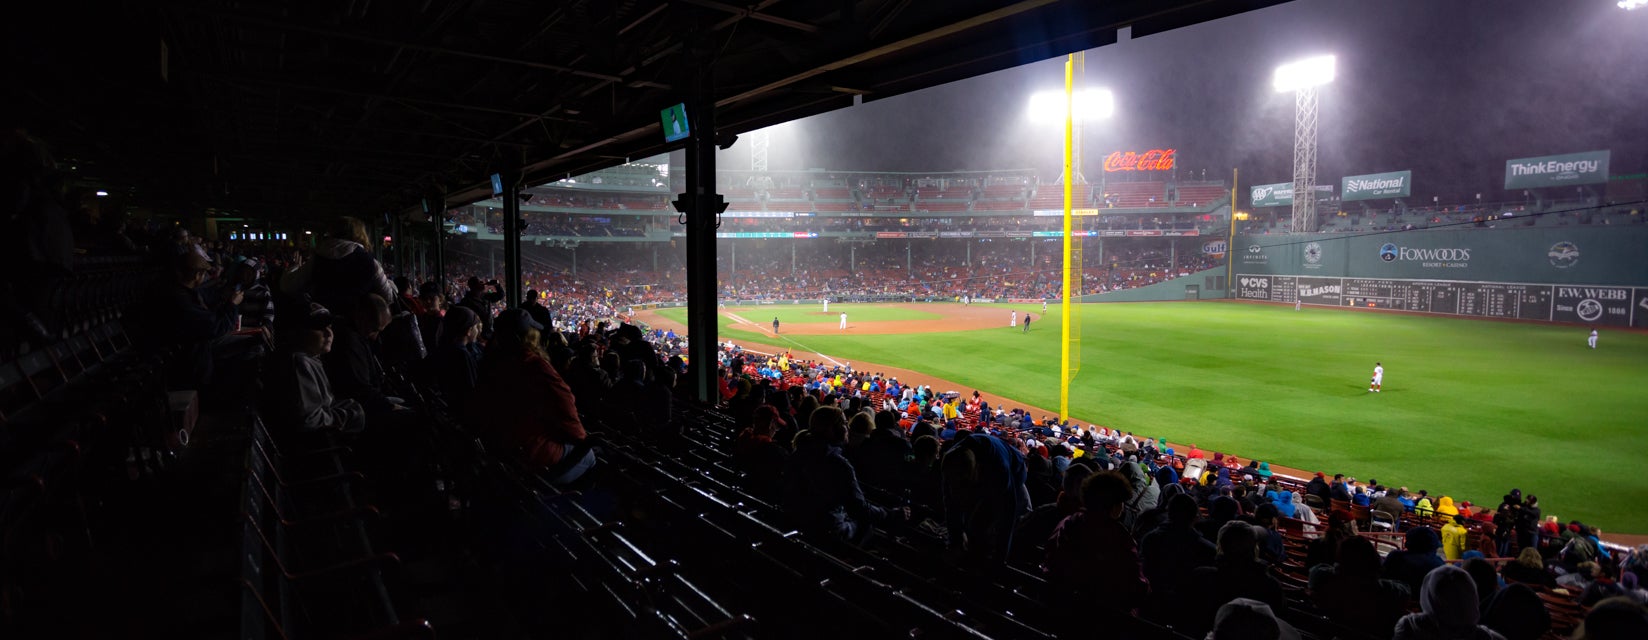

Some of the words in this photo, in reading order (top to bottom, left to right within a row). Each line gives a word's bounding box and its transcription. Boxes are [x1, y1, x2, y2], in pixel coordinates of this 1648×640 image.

[1104, 149, 1176, 172] Coca-Cola
[1359, 176, 1404, 190] National
[1203, 244, 1226, 252] Gulf
[1400, 247, 1471, 260] FOXWOODS
[1249, 278, 1268, 288] CVS
[1241, 288, 1268, 298] Health
[1584, 288, 1627, 299] WEBB
